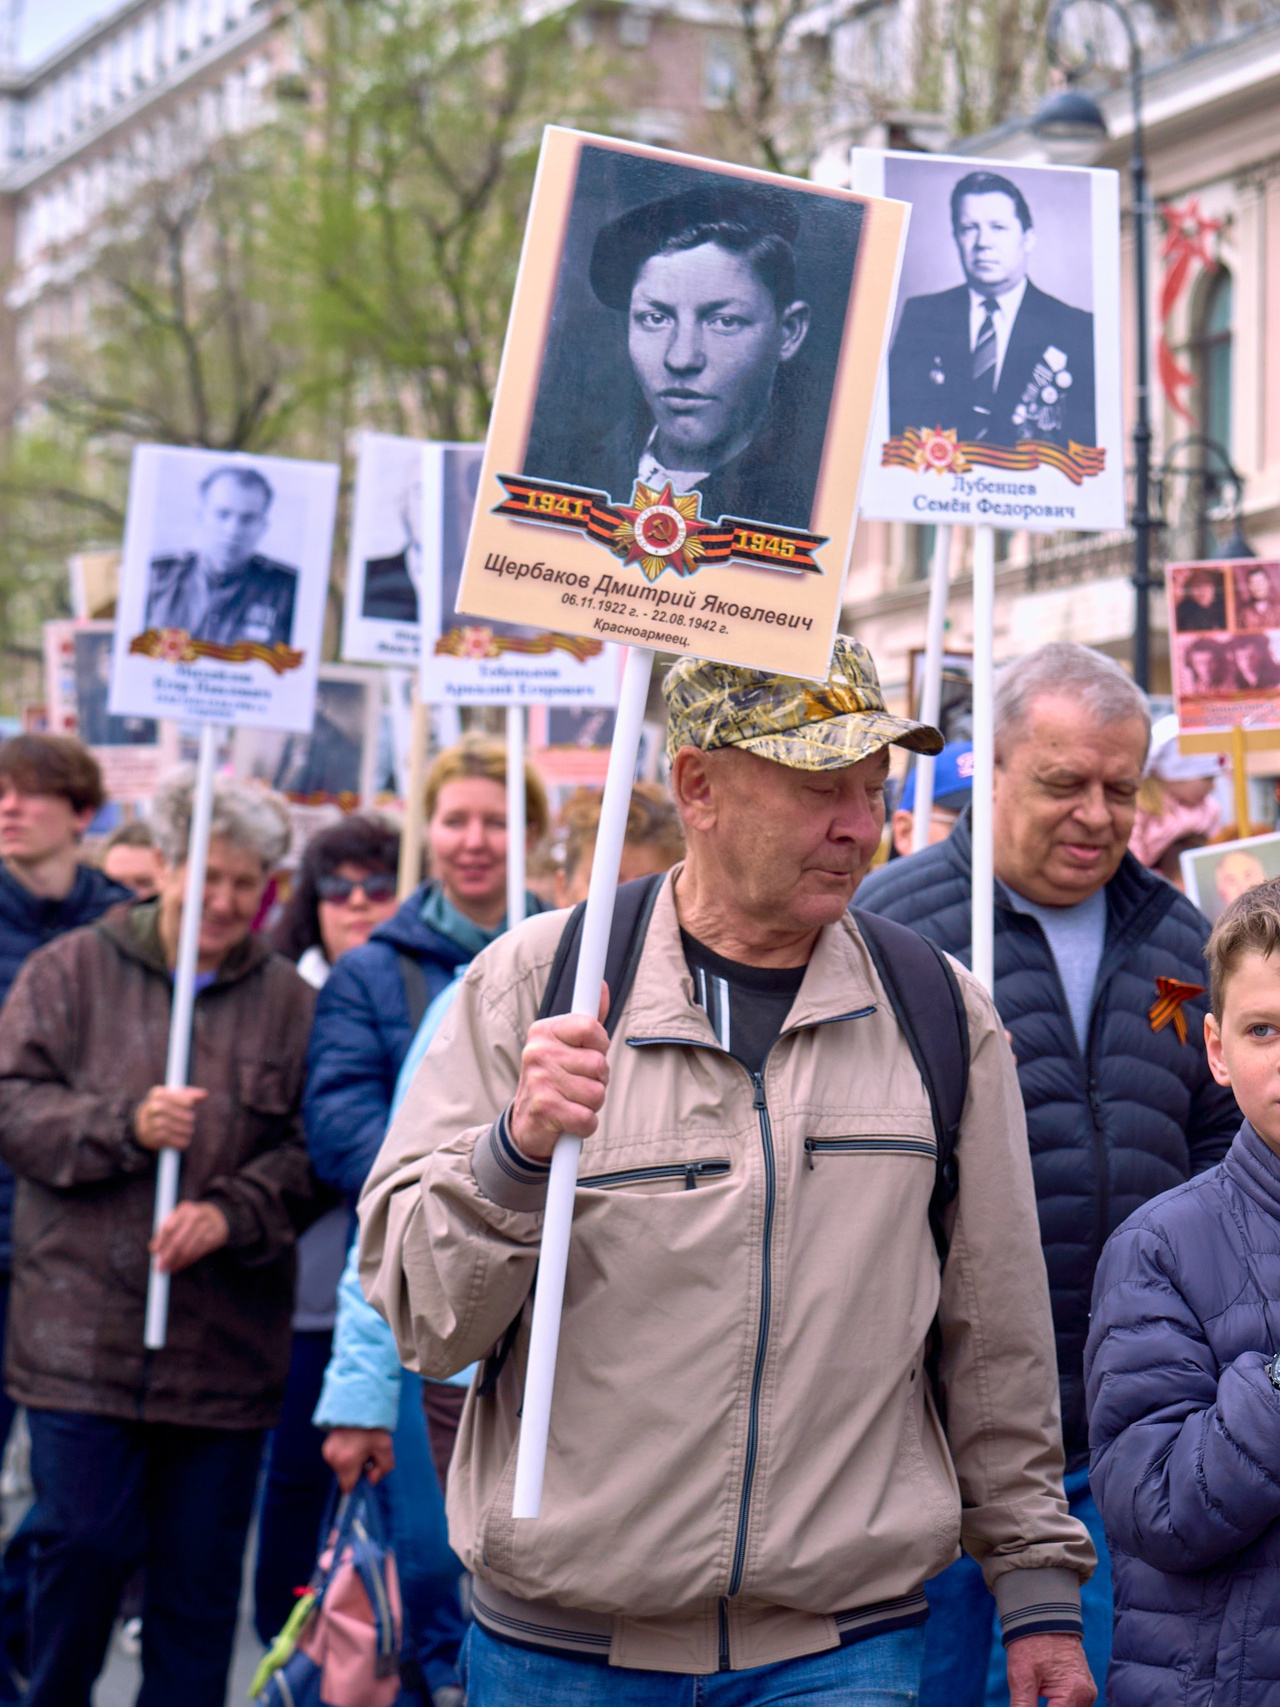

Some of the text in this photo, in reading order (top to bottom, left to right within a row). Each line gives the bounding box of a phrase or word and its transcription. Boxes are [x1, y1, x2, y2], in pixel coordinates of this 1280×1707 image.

[951, 475, 1038, 497] Лубенцев
[525, 490, 585, 519] 1941
[912, 495, 1076, 521] Семён Федорович
[735, 530, 797, 560] 1945
[484, 552, 813, 631] Щербаков Дмитрий Яковлевич
[561, 592, 628, 617] 06.11.1922
[650, 609, 716, 632] 22.08.1942
[593, 617, 691, 648] Красноармеец.
